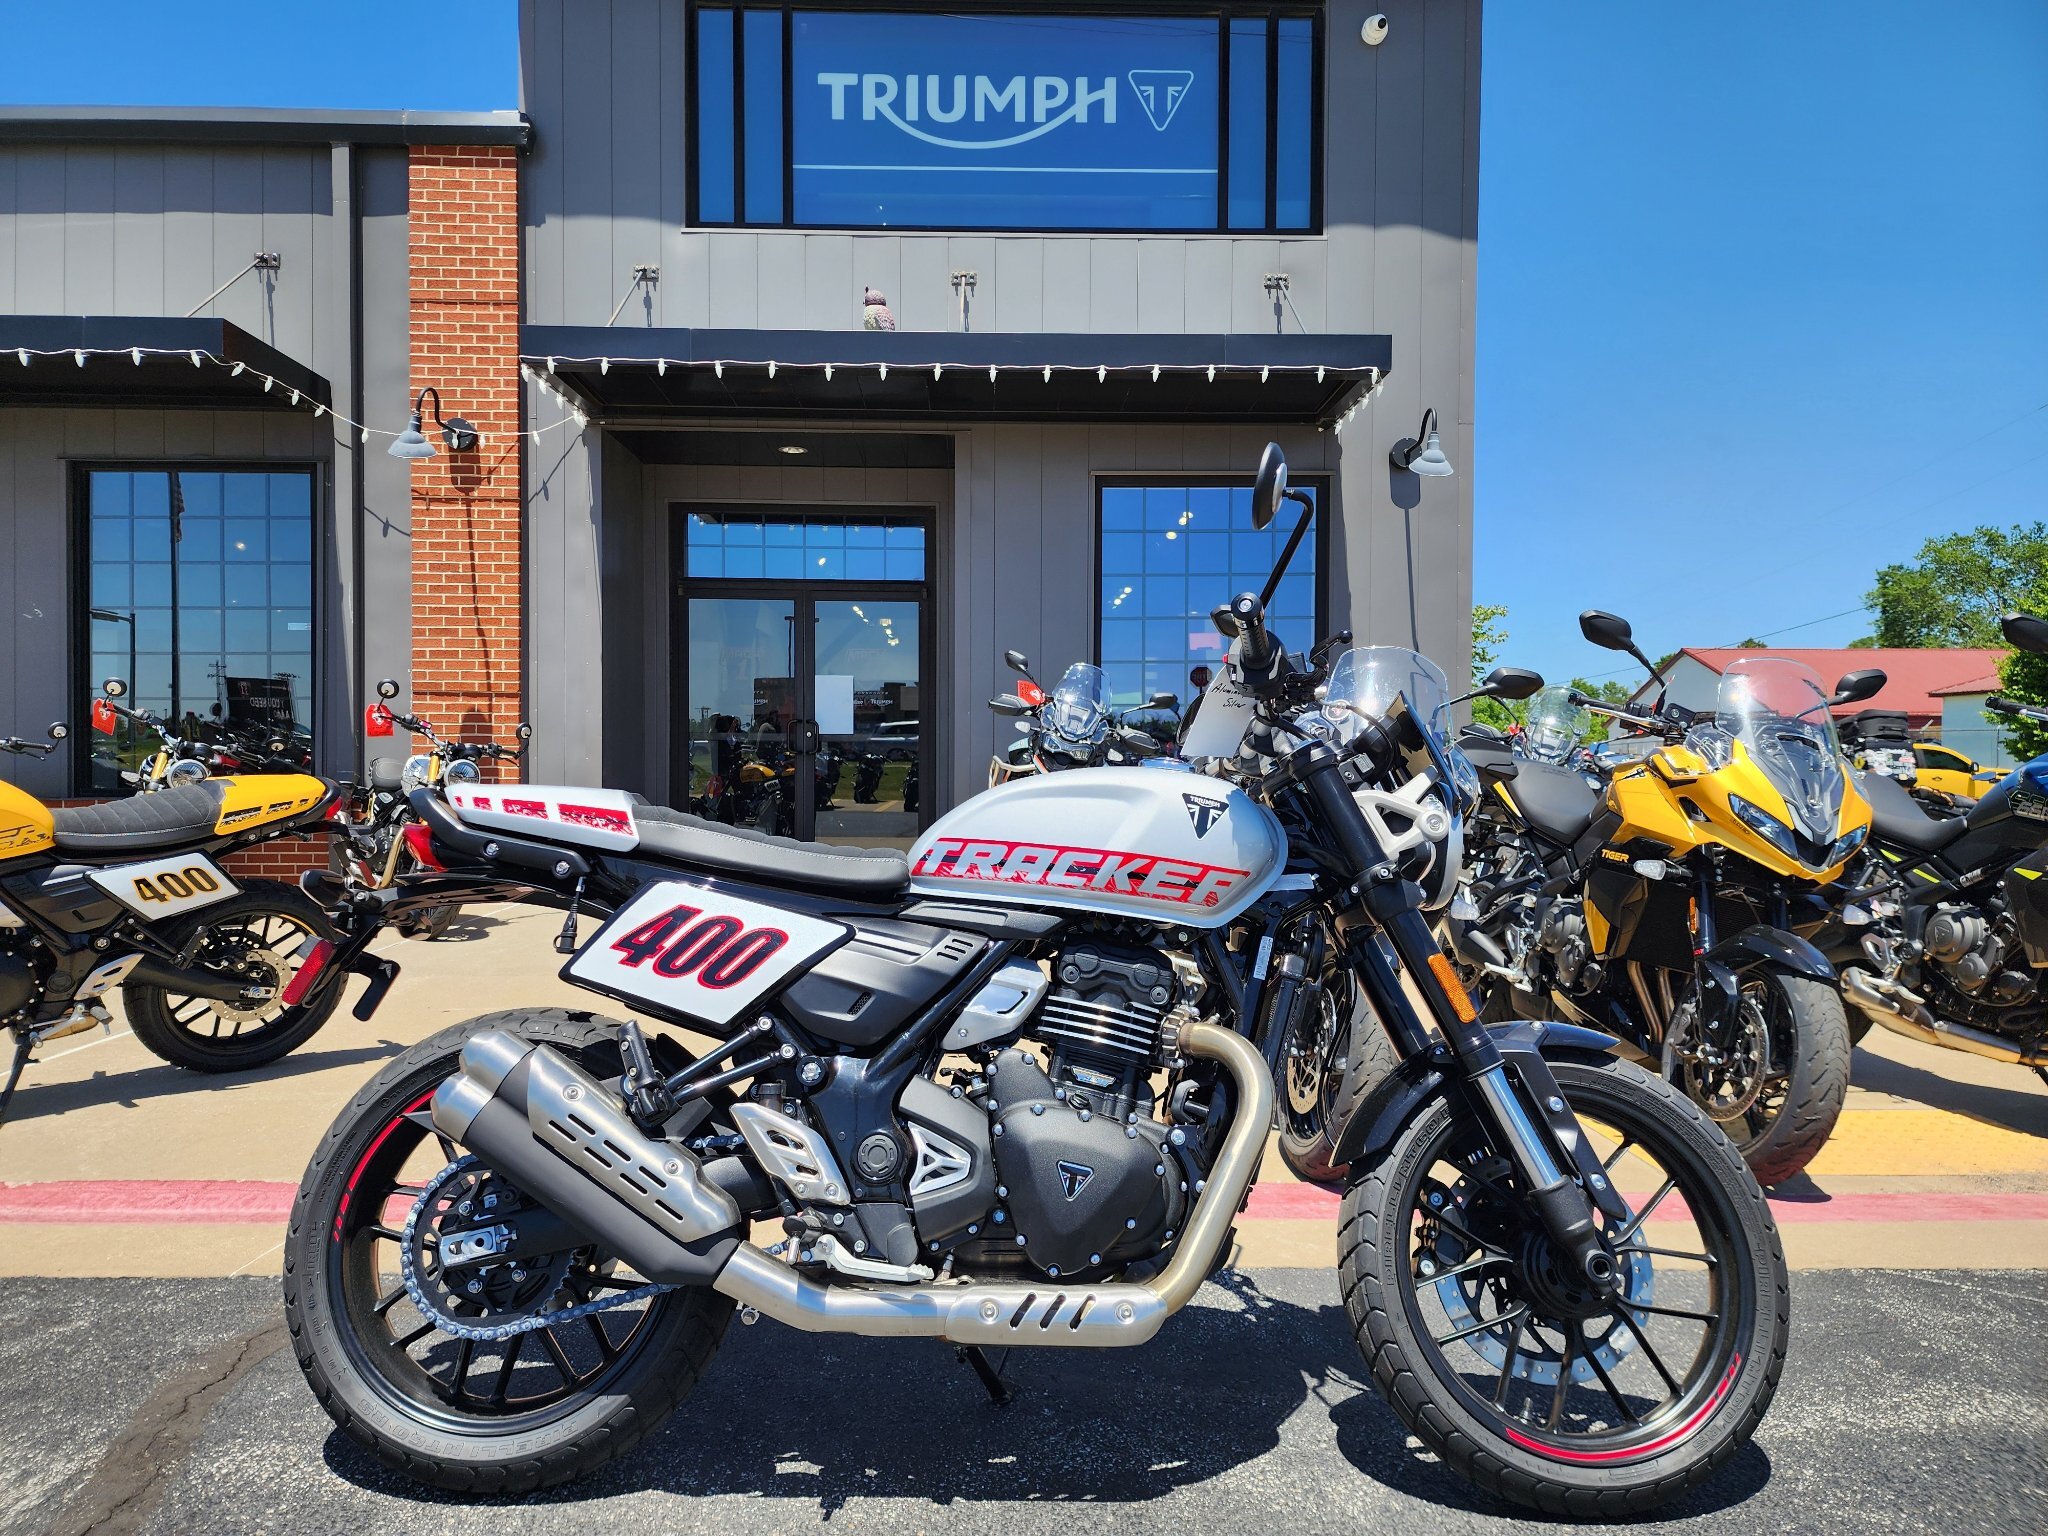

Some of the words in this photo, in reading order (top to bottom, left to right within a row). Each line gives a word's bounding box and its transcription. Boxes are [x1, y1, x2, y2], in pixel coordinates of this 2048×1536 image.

[817, 72, 1117, 149] TRIUMPH
[1190, 796, 1221, 808] TRIUMPH
[925, 842, 1248, 905] TRACKER
[1602, 849, 1629, 863] TIGER
[132, 866, 220, 903] 400
[609, 904, 789, 989] 400
[356, 1398, 389, 1430] RS
[469, 1420, 579, 1458] PIRELLI
